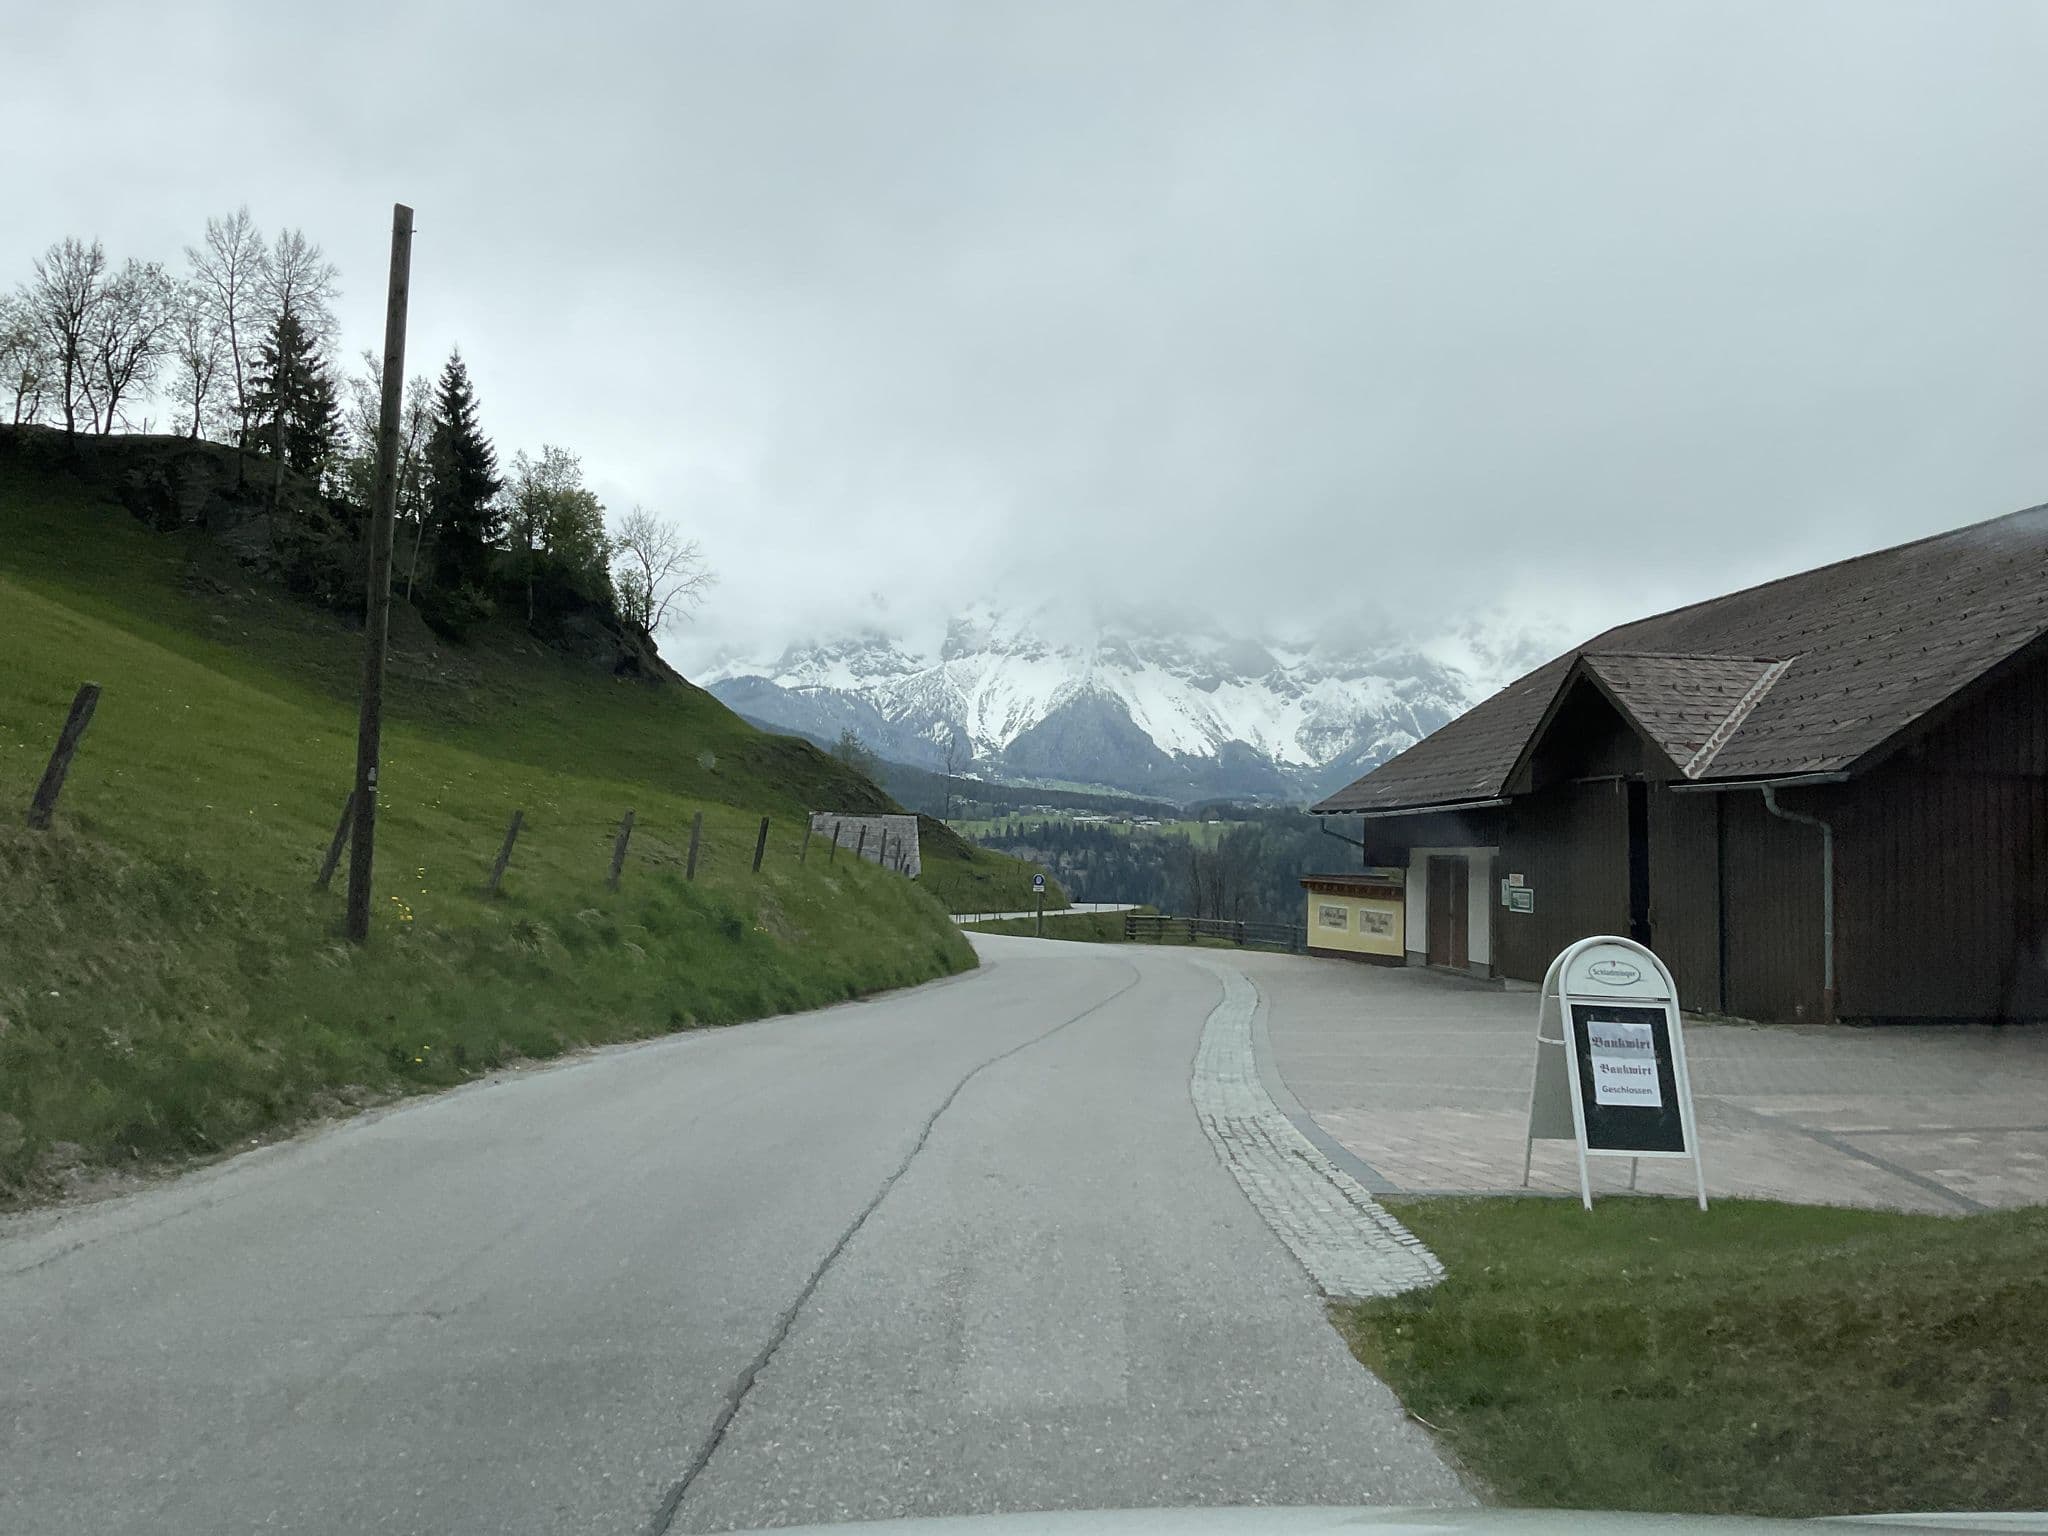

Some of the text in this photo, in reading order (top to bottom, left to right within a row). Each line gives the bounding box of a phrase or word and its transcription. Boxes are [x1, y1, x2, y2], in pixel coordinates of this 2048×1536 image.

[1591, 1036, 1651, 1049] Bankwirt
[1599, 1063, 1652, 1076] Bankwirt
[1602, 1085, 1653, 1095] Geschlossen
